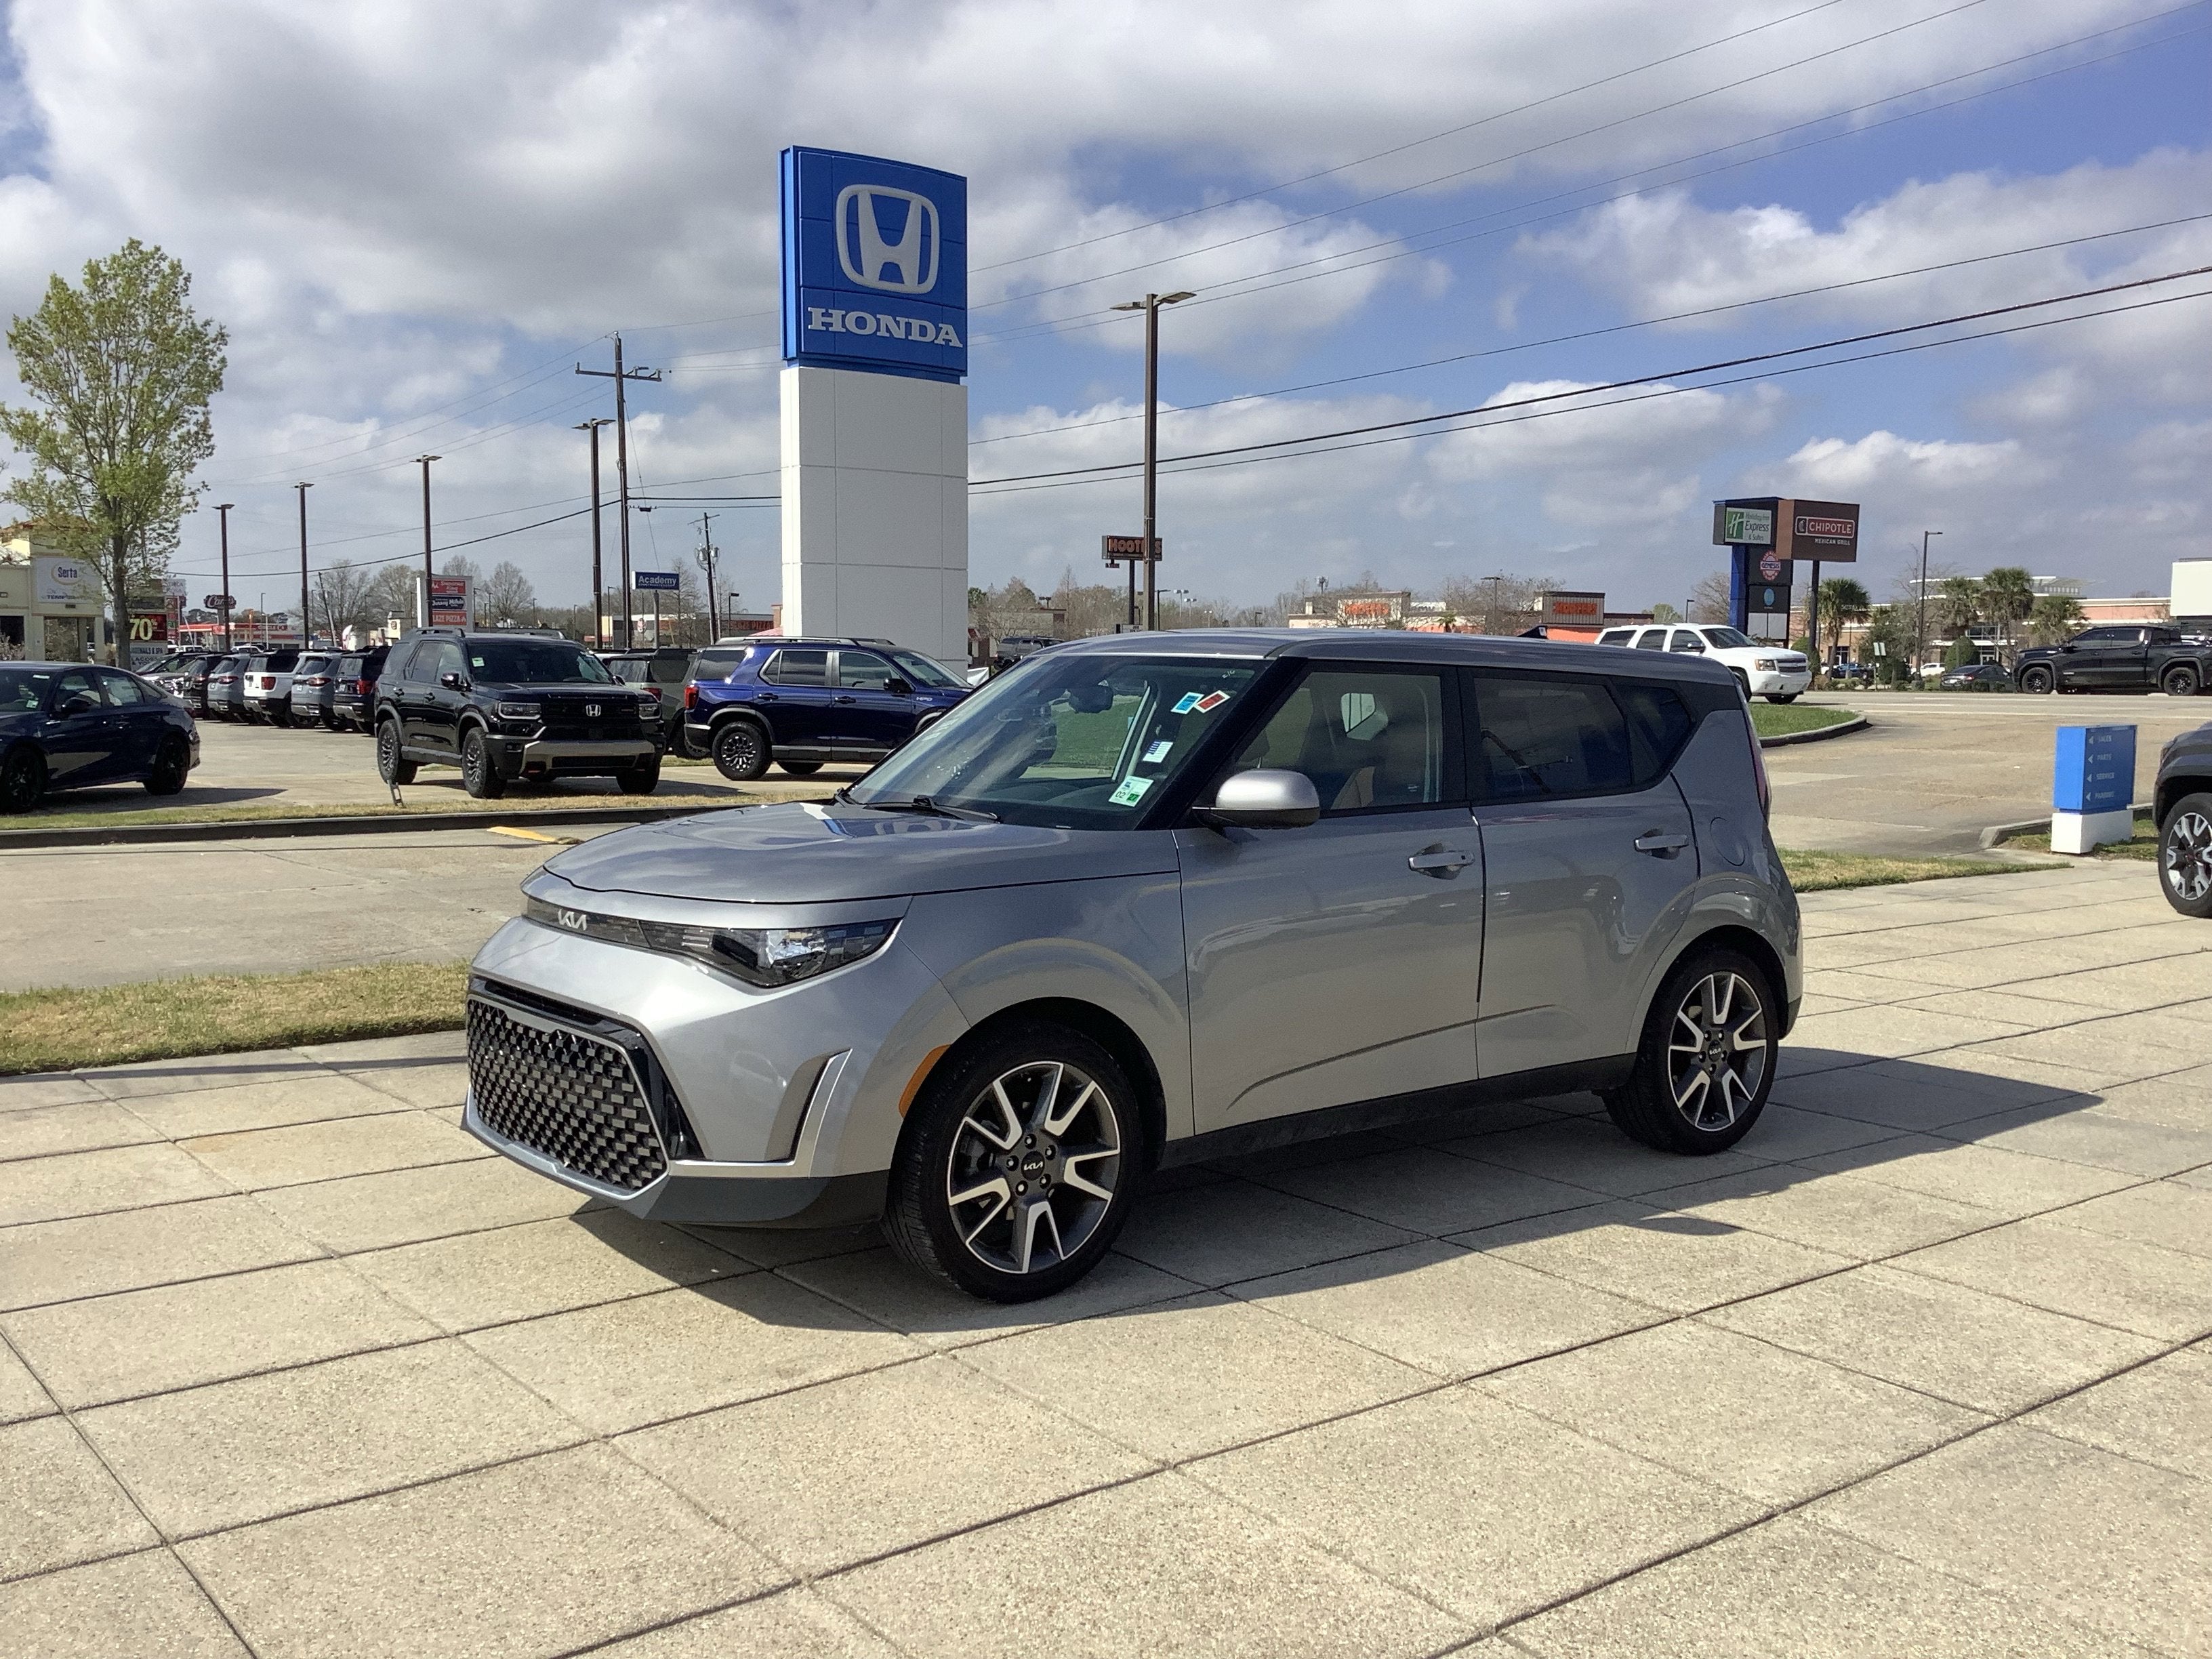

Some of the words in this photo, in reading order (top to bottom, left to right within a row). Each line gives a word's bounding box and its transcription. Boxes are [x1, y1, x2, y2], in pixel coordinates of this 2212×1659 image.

[808, 307, 963, 348] HONDA
[1745, 520, 1769, 533] Express
[1809, 521, 1853, 534] CHIPOTLE
[58, 567, 78, 578] Serta
[638, 575, 677, 587] Academy
[129, 618, 152, 640] 70
[1115, 791, 1126, 799] 02
[1127, 793, 1140, 801] 27
